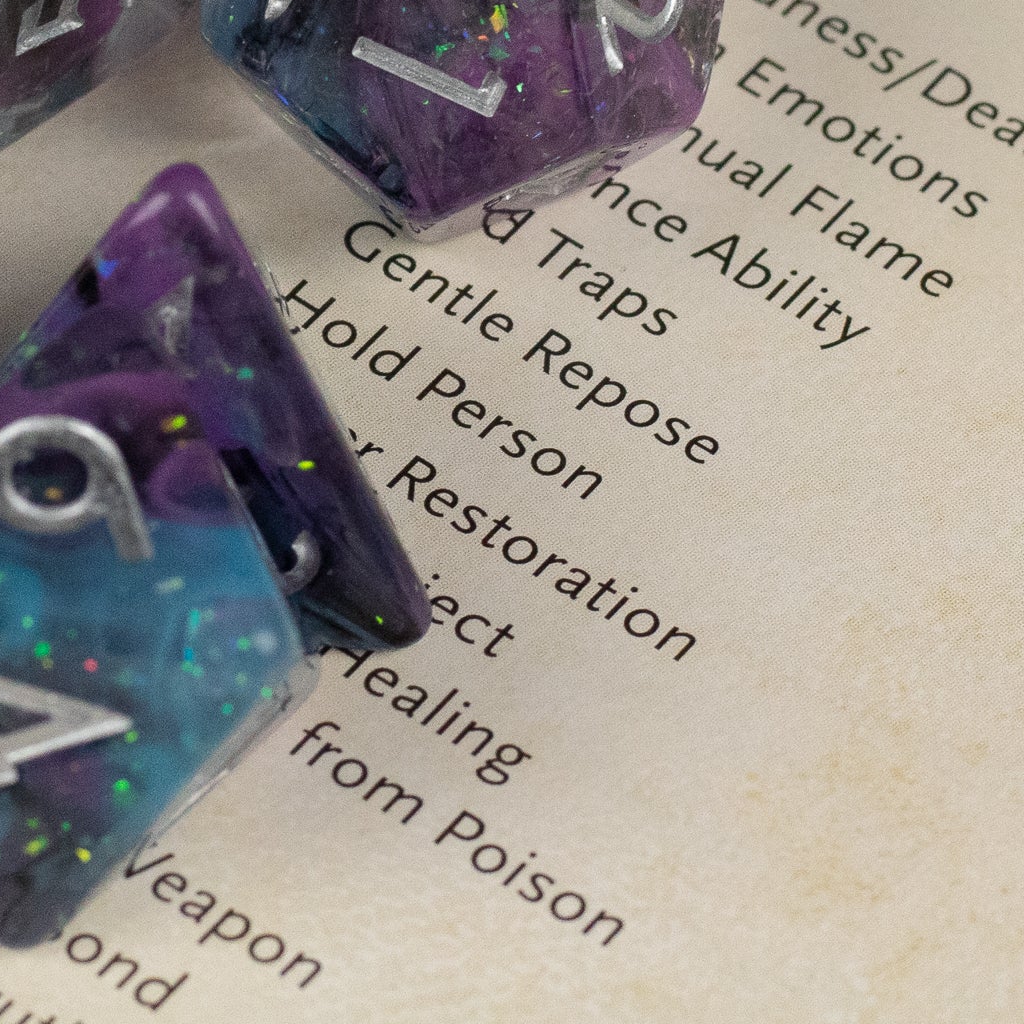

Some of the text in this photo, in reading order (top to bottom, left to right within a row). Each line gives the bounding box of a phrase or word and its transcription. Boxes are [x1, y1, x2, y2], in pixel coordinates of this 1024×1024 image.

[736, 56, 989, 219] Emotions
[535, 227, 679, 338] Traps
[690, 232, 872, 351] Ability
[789, 183, 957, 299] Flame
[276, 279, 605, 503] Hold Person
[342, 217, 722, 466] Gentle Repose
[386, 454, 699, 664] Restoration
[420, 572, 517, 660] ect
[319, 641, 532, 787] Healing
[288, 720, 625, 948] from Poison
[50, 924, 190, 1012] ond
